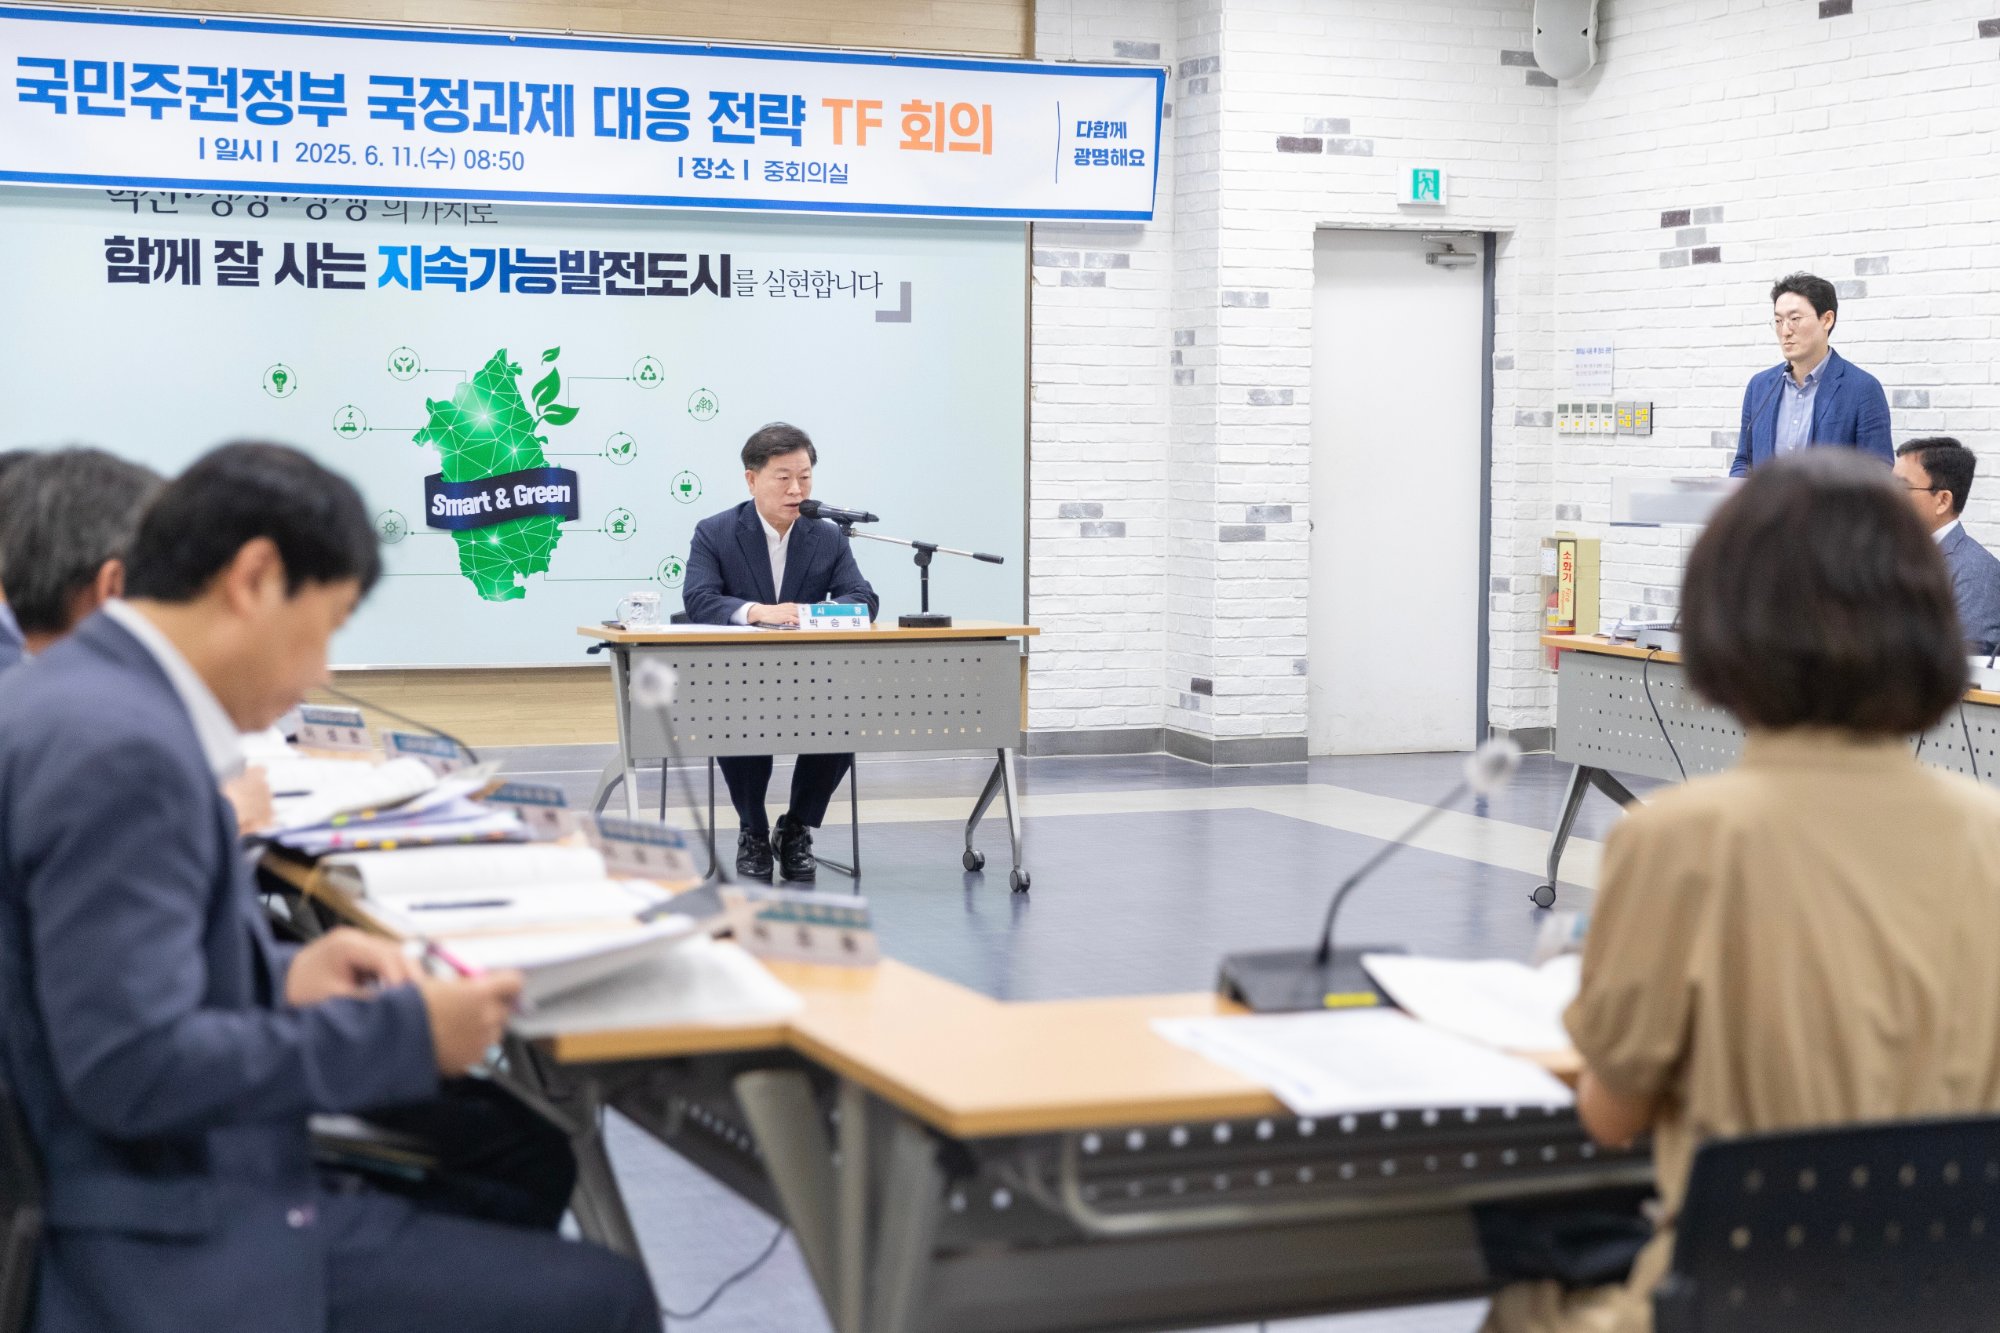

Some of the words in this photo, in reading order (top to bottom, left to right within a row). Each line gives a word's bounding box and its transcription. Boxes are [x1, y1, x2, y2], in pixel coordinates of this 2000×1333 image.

[16, 56, 348, 127] 국민주권정부
[367, 75, 575, 137] 국정과제
[593, 86, 691, 143] 대응
[707, 90, 806, 147] 전략
[821, 97, 883, 147] TF
[899, 99, 993, 156] 회의
[1076, 120, 1128, 140] 다함께
[295, 142, 357, 166] 2025.
[364, 145, 384, 167] 6.
[463, 149, 525, 171] 08:50
[690, 156, 735, 180] 장소
[763, 160, 849, 185] 중회의실
[1073, 147, 1146, 167] 광명해요
[104, 235, 201, 286] 함께
[214, 240, 264, 287] 잘
[274, 242, 367, 290] 사는
[762, 268, 884, 300] 실현합니다
[431, 490, 493, 517] Smart
[495, 487, 512, 510] &
[513, 484, 571, 507] Green
[1562, 550, 1572, 582] 소화기
